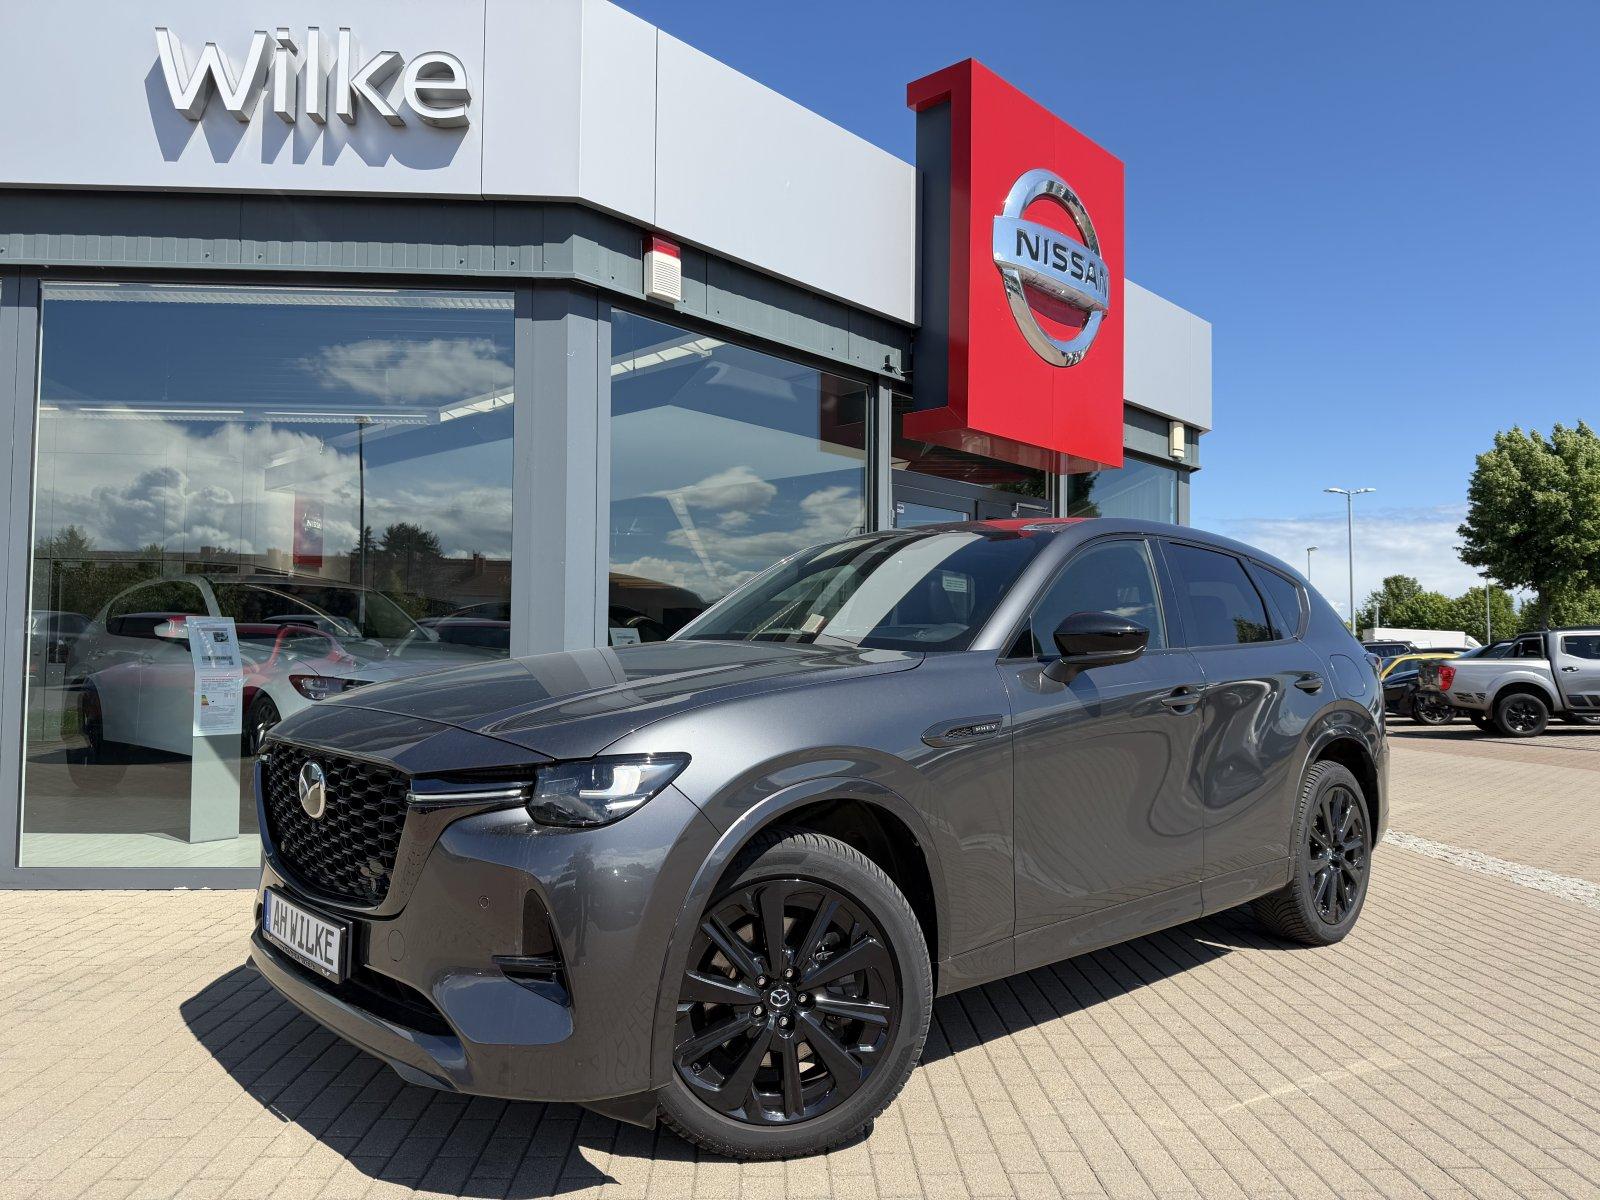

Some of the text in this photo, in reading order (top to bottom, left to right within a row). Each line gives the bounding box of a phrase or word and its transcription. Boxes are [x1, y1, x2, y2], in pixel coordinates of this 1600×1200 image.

[154, 26, 471, 127] Wilke
[1016, 228, 1108, 298] NISSAN
[273, 900, 288, 939] AH
[290, 909, 335, 966] WILKE
